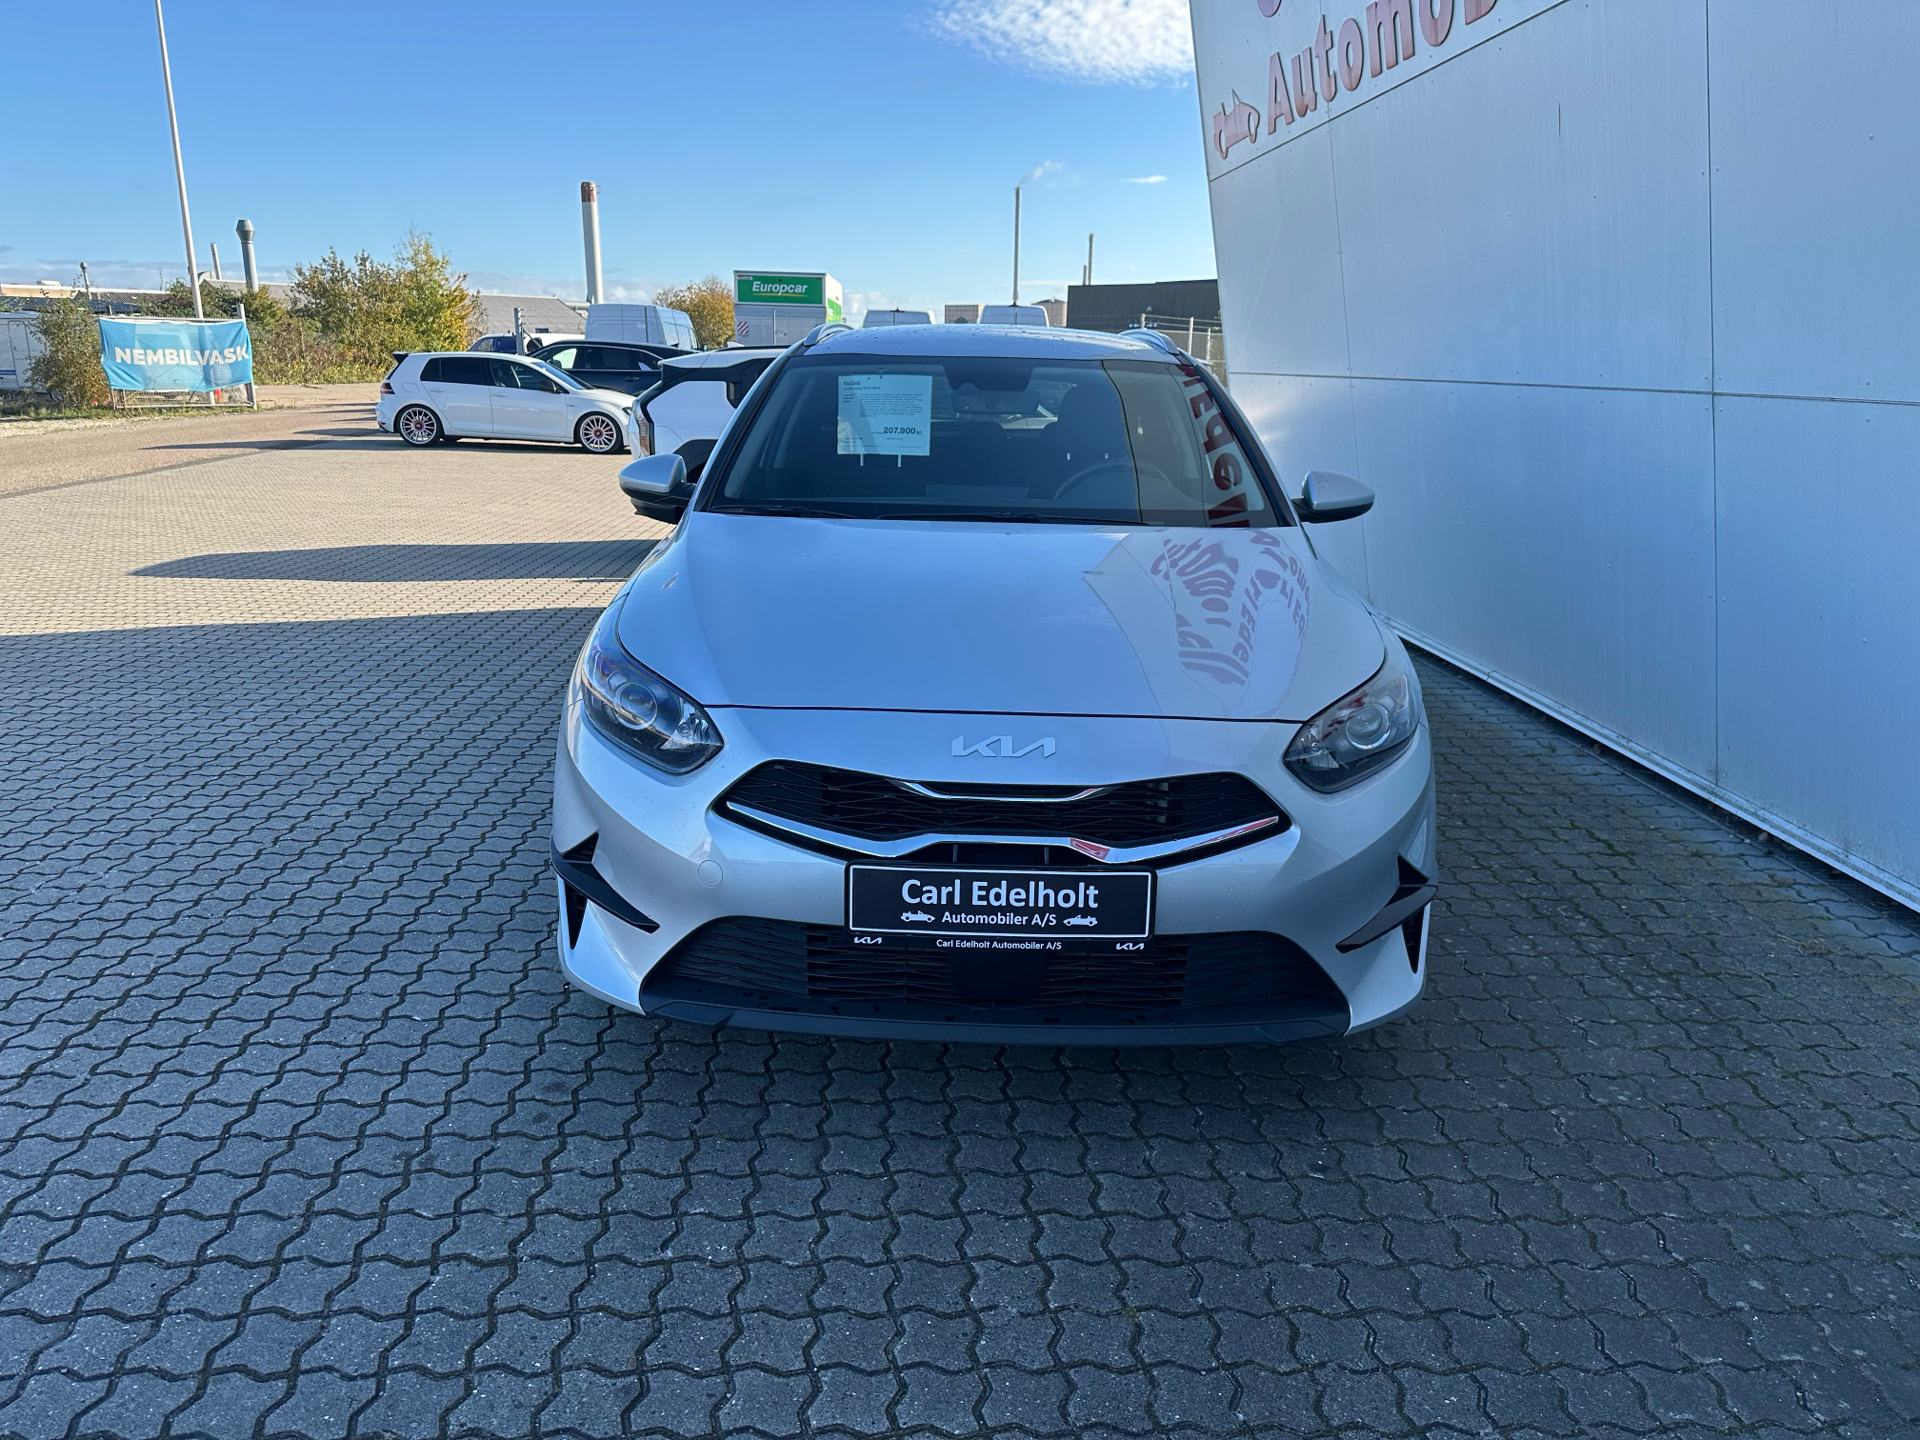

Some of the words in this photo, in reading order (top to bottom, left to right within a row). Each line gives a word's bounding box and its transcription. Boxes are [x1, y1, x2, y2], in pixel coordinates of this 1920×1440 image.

[1267, 0, 1499, 136] Automo
[752, 281, 808, 296] Europcar
[114, 343, 250, 366] NEMBILVASK
[883, 426, 916, 435] 207.900
[951, 735, 1056, 759] KIA
[901, 879, 961, 906] Carl
[971, 880, 1099, 909] Edelholt
[941, 911, 1029, 927] Automobiler
[1031, 913, 1057, 927] A/S
[853, 935, 882, 945] KIA
[936, 939, 954, 949] Carl
[955, 939, 990, 949] Edelholt
[991, 940, 1044, 950] Automobiler
[1045, 941, 1062, 950] A/S
[1115, 942, 1145, 951] KIA
